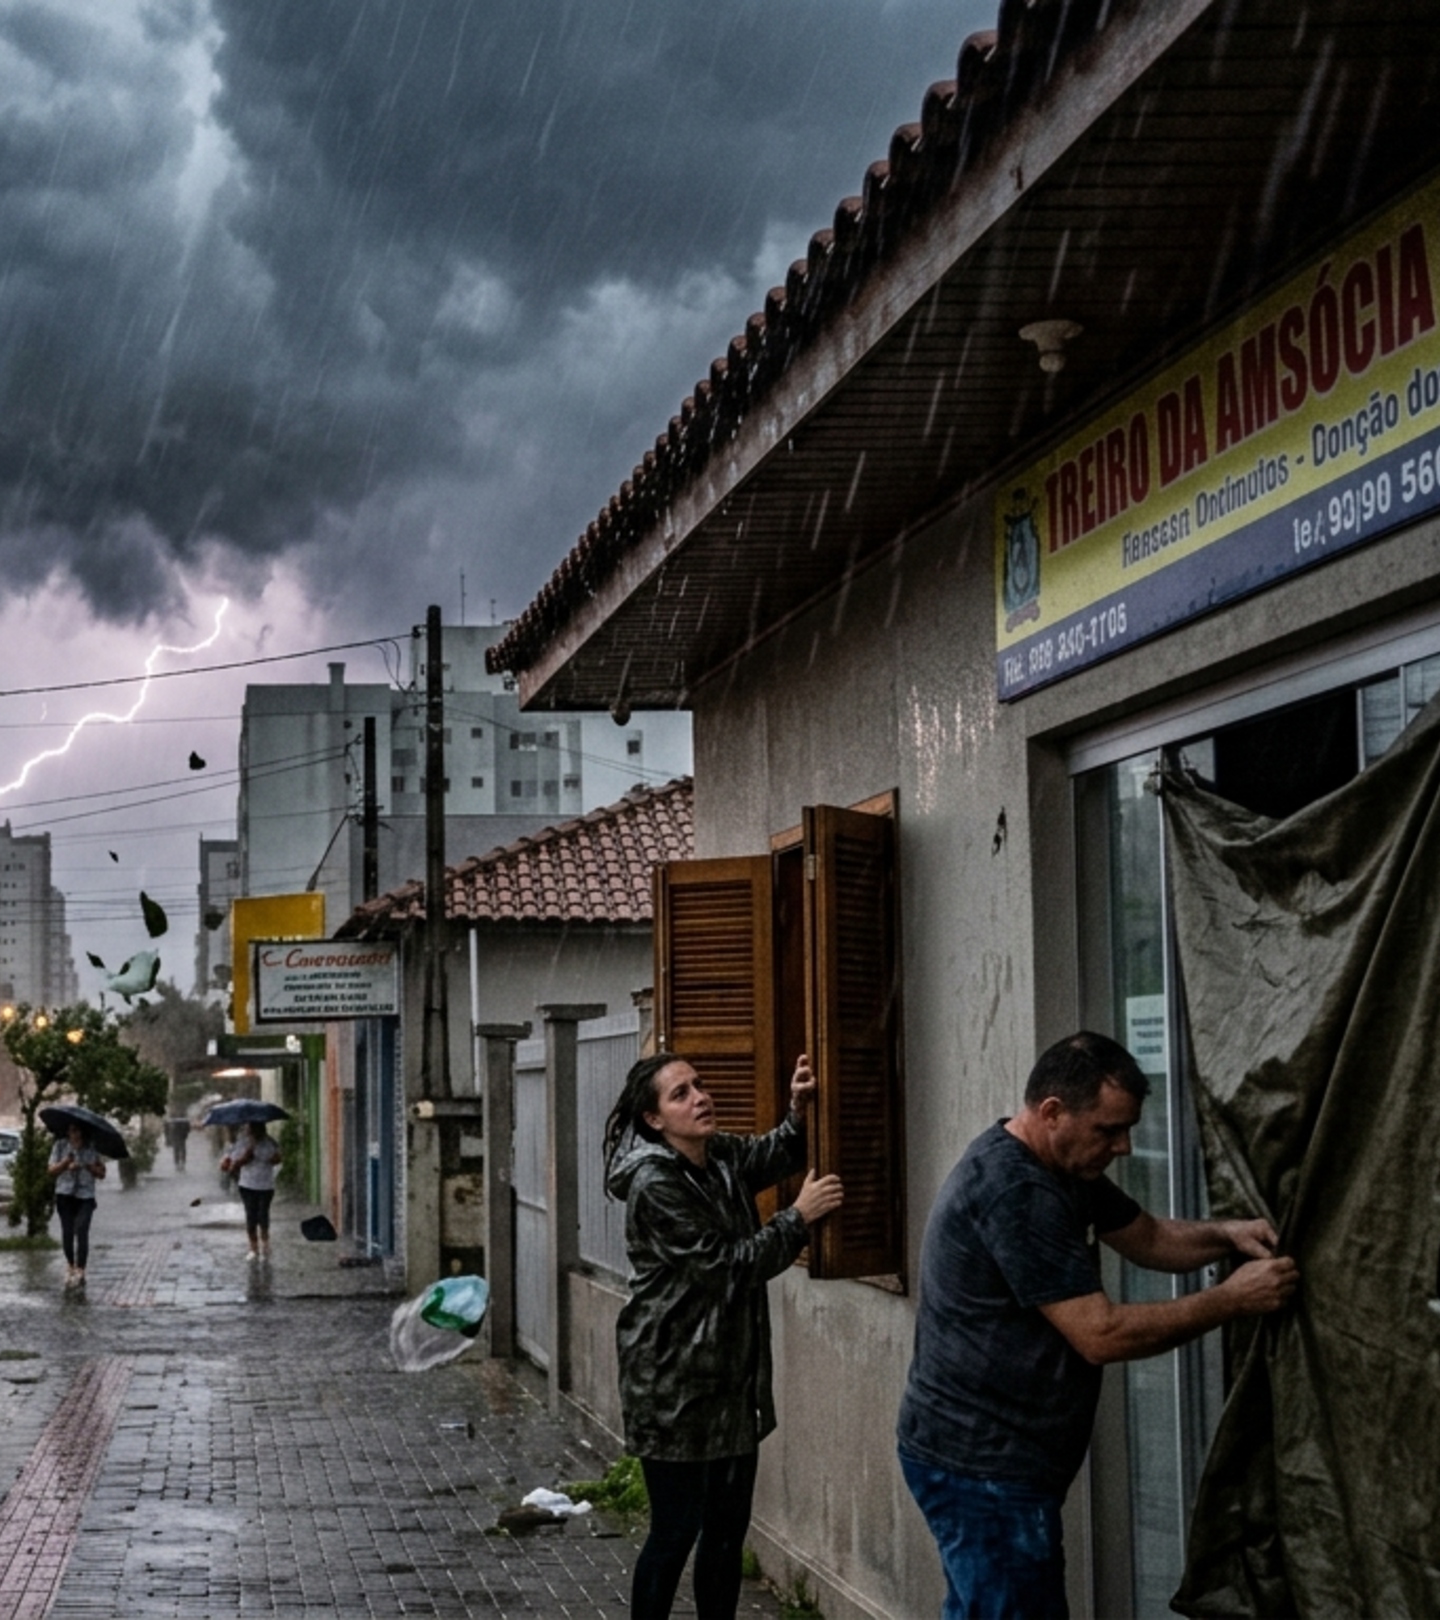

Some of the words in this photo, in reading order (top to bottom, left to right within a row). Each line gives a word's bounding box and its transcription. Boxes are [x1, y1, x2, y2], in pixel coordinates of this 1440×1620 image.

[1045, 412, 1149, 552] TREIRO
[1157, 375, 1207, 486] DA
[1216, 223, 1435, 453] AMSÓCIA
[1312, 391, 1399, 467] Donção
[1408, 368, 1440, 416] do
